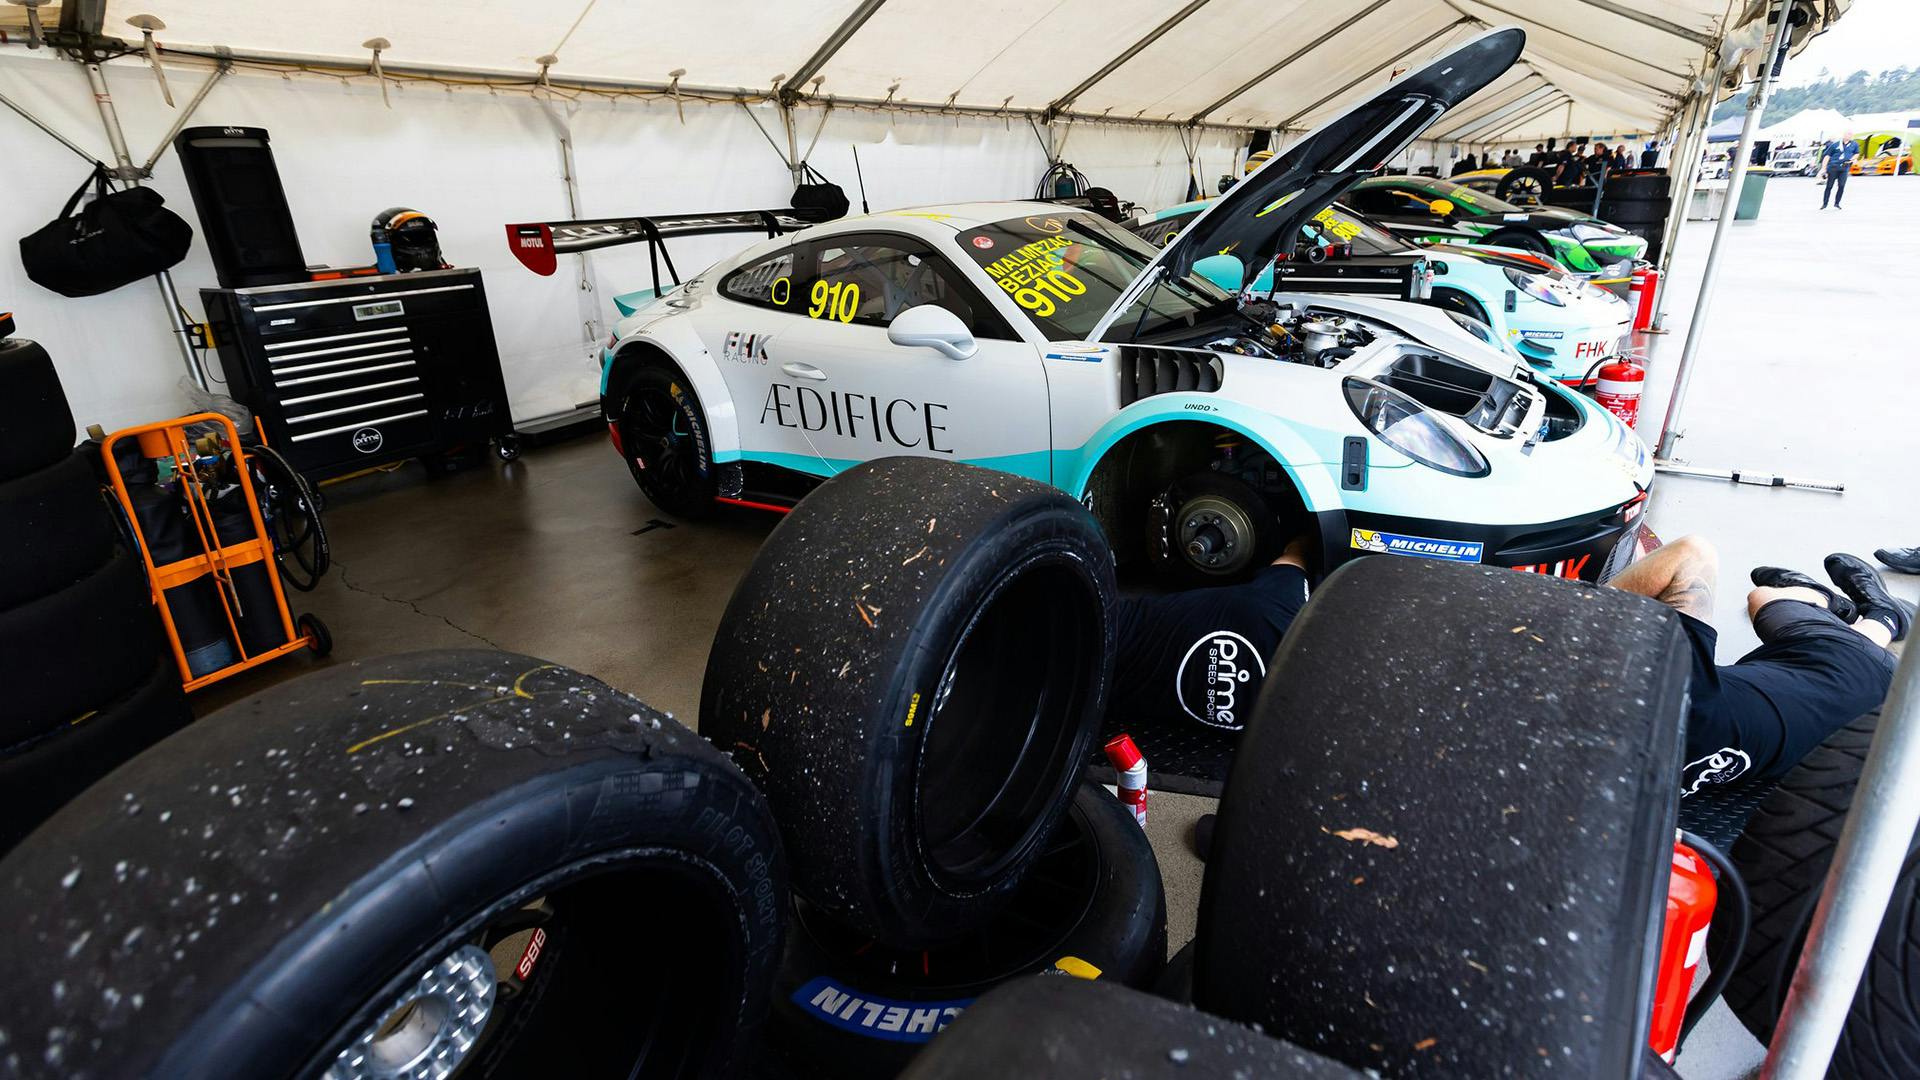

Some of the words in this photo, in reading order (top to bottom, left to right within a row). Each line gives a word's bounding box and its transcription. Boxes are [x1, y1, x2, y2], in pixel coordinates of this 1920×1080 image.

[520, 237, 544, 248] MOTUL
[984, 235, 1073, 279] MALMEZAC
[997, 253, 1064, 294] BEZIAC
[808, 280, 860, 323] 910
[1014, 269, 1087, 317] 910
[723, 331, 774, 359] FHK
[724, 350, 768, 365] RACING
[1575, 340, 1608, 358] FHK
[1184, 403, 1211, 412] UNDO
[355, 434, 380, 446] prime
[683, 404, 706, 471] MICHELIN
[1389, 537, 1480, 557] MICHELIN
[1208, 648, 1218, 685] SPEED
[1213, 639, 1250, 724] prime
[1206, 688, 1216, 720] SPORT
[518, 928, 546, 977] BBS
[811, 984, 966, 1034] CHELIN
